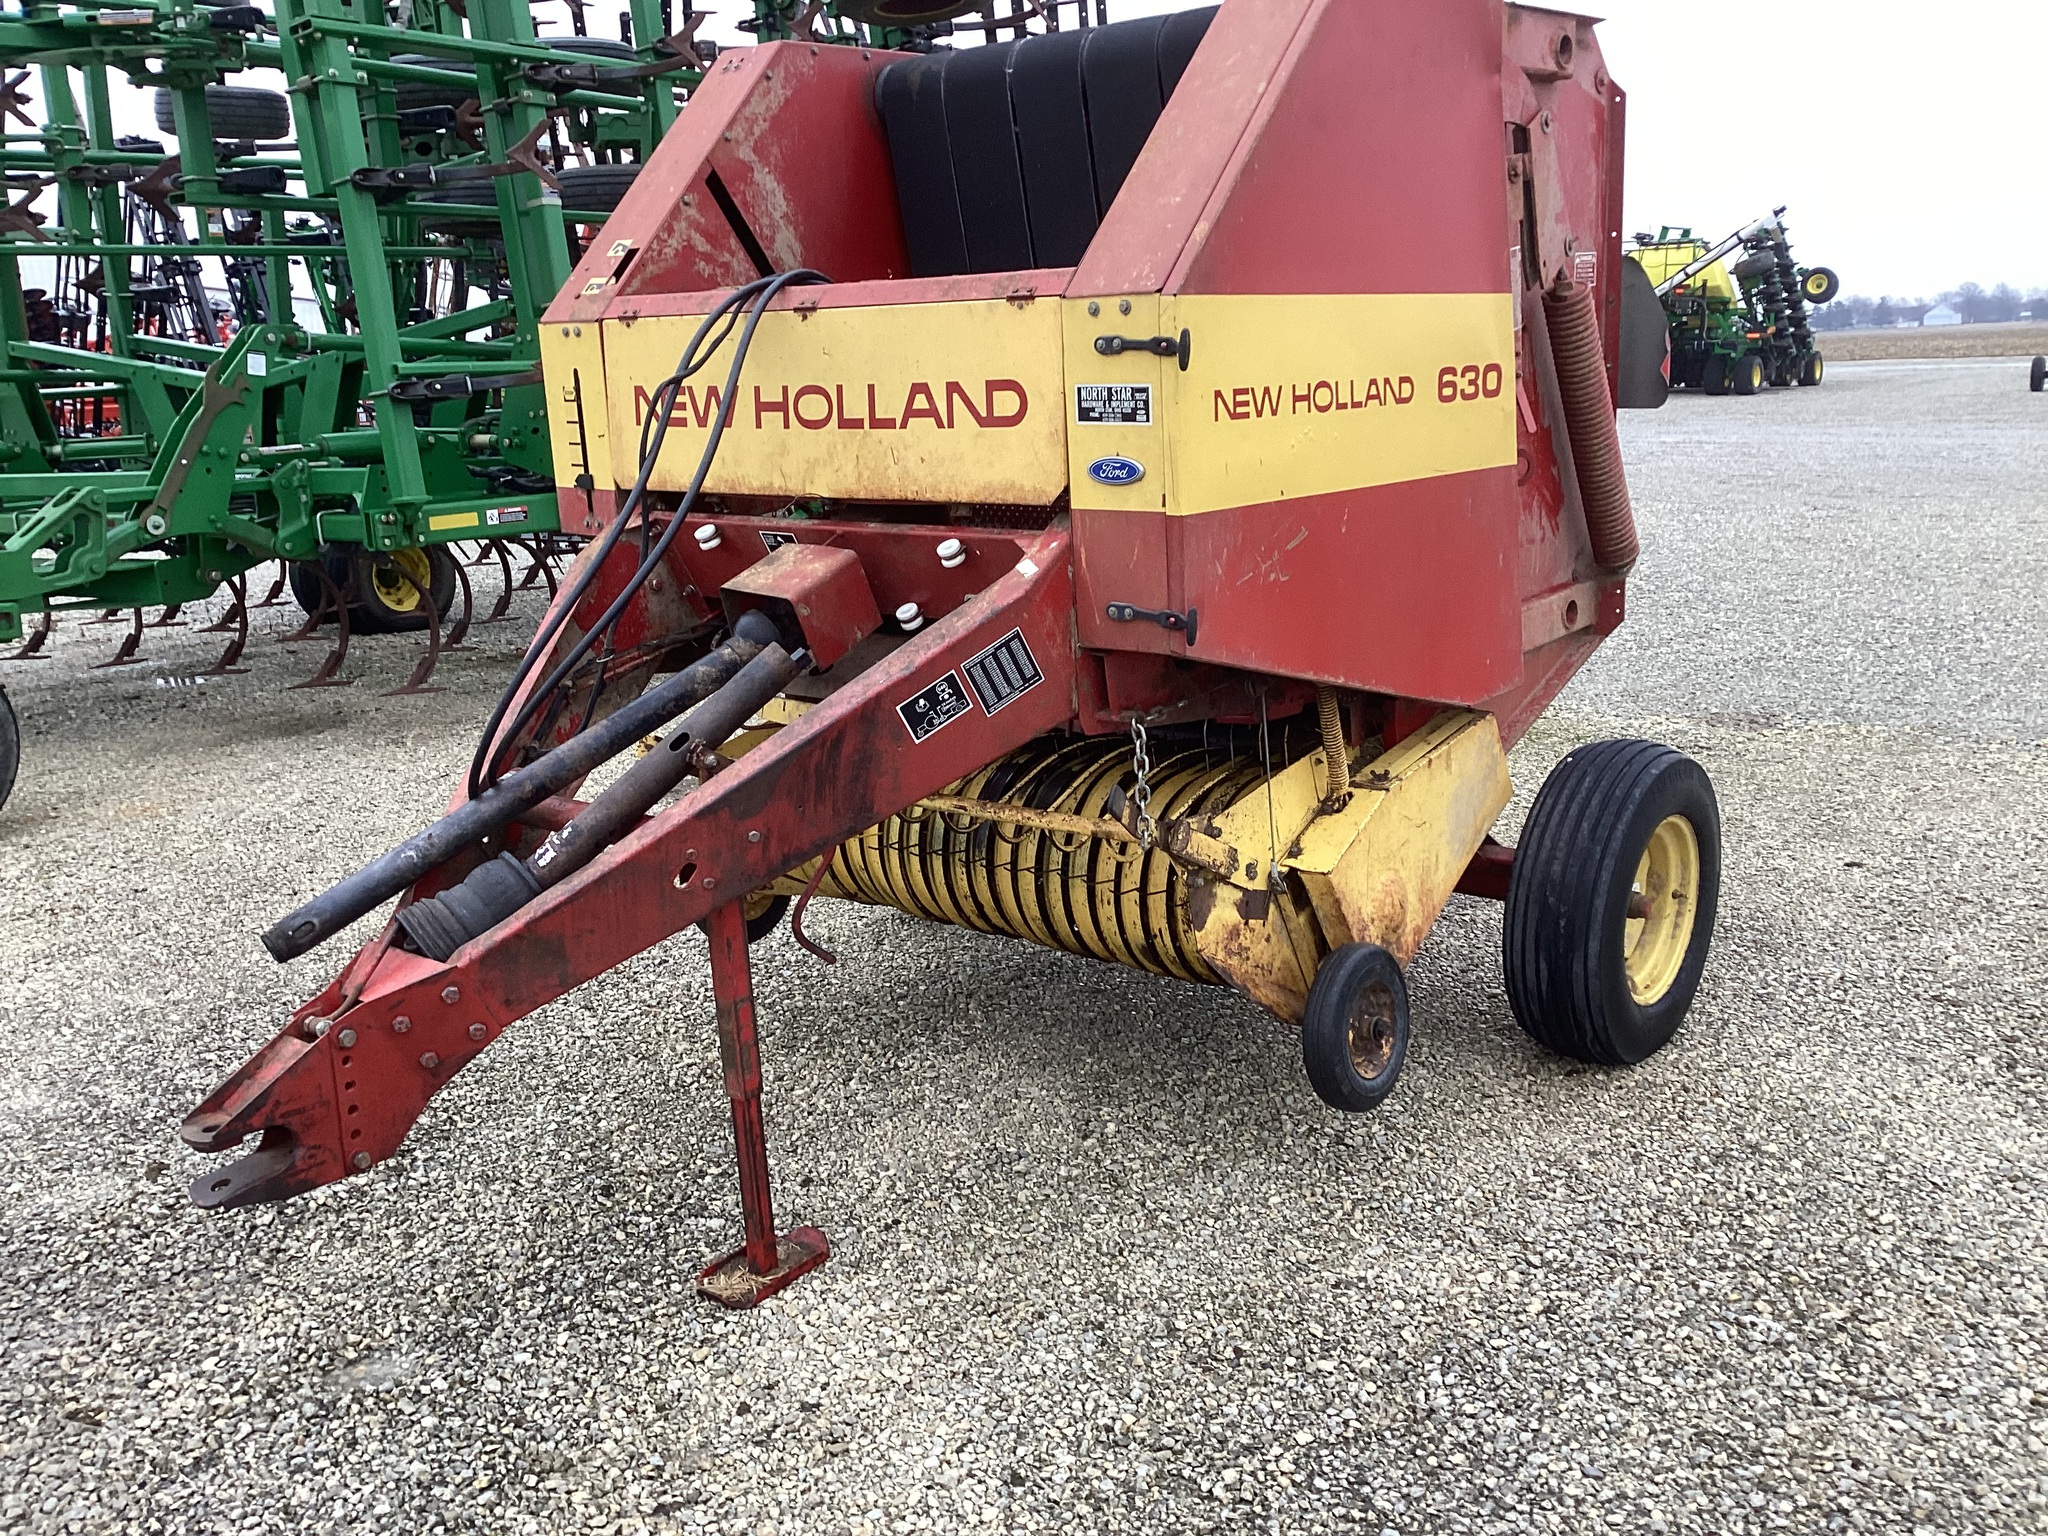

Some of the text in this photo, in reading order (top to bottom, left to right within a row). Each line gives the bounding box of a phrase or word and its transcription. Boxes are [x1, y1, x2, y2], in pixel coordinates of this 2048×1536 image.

[633, 379, 1029, 430] NEW HOLLAND
[1080, 387, 1108, 401] NORTH
[1111, 387, 1132, 401] STAR
[1214, 362, 1503, 422] NEW HOLLAND 630
[1099, 462, 1129, 478] Ford
